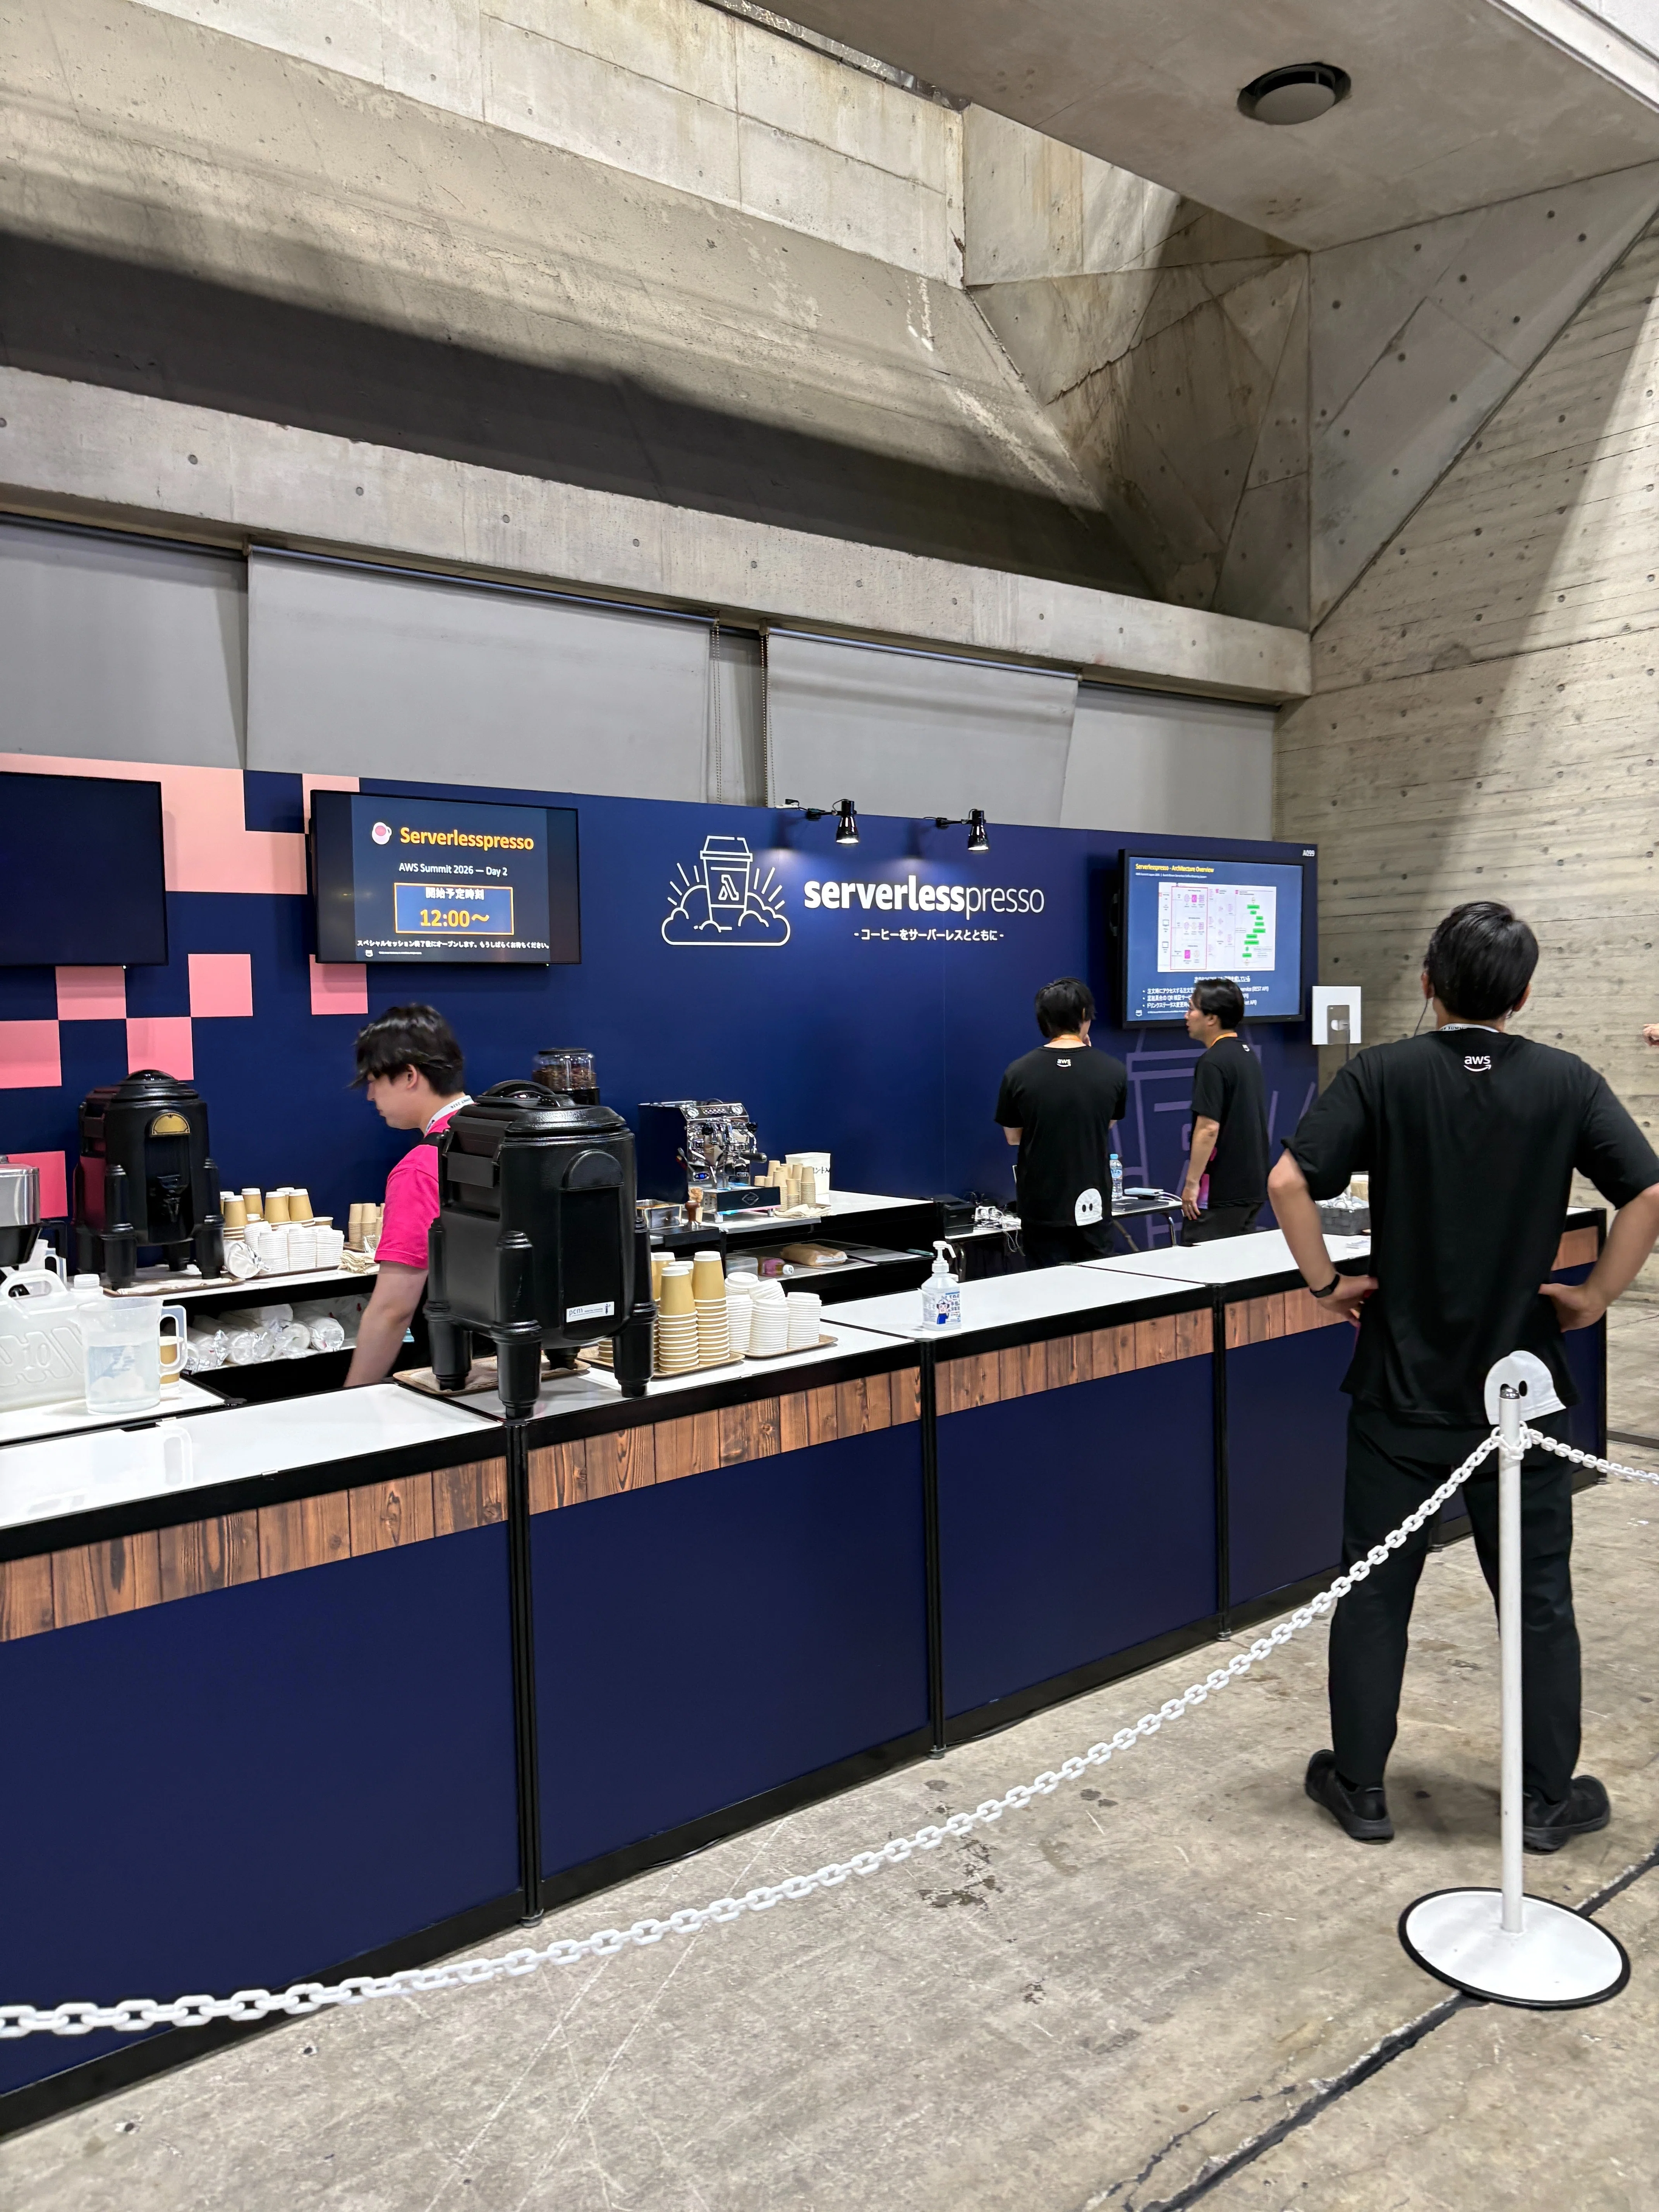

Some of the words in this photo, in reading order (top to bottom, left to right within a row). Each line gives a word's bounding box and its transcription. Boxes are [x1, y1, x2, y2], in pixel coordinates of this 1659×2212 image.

[400, 827, 534, 851] Serverlesspresso
[399, 862, 419, 872] AWS
[420, 863, 452, 874] Summit
[453, 865, 474, 874] 2026
[486, 867, 501, 877] Day
[502, 867, 508, 876] 2
[425, 886, 484, 900] 開始予定時刻
[804, 874, 1044, 921] serverlesspresso
[1464, 1056, 1491, 1064] aws
[569, 1308, 583, 1317] pcm
